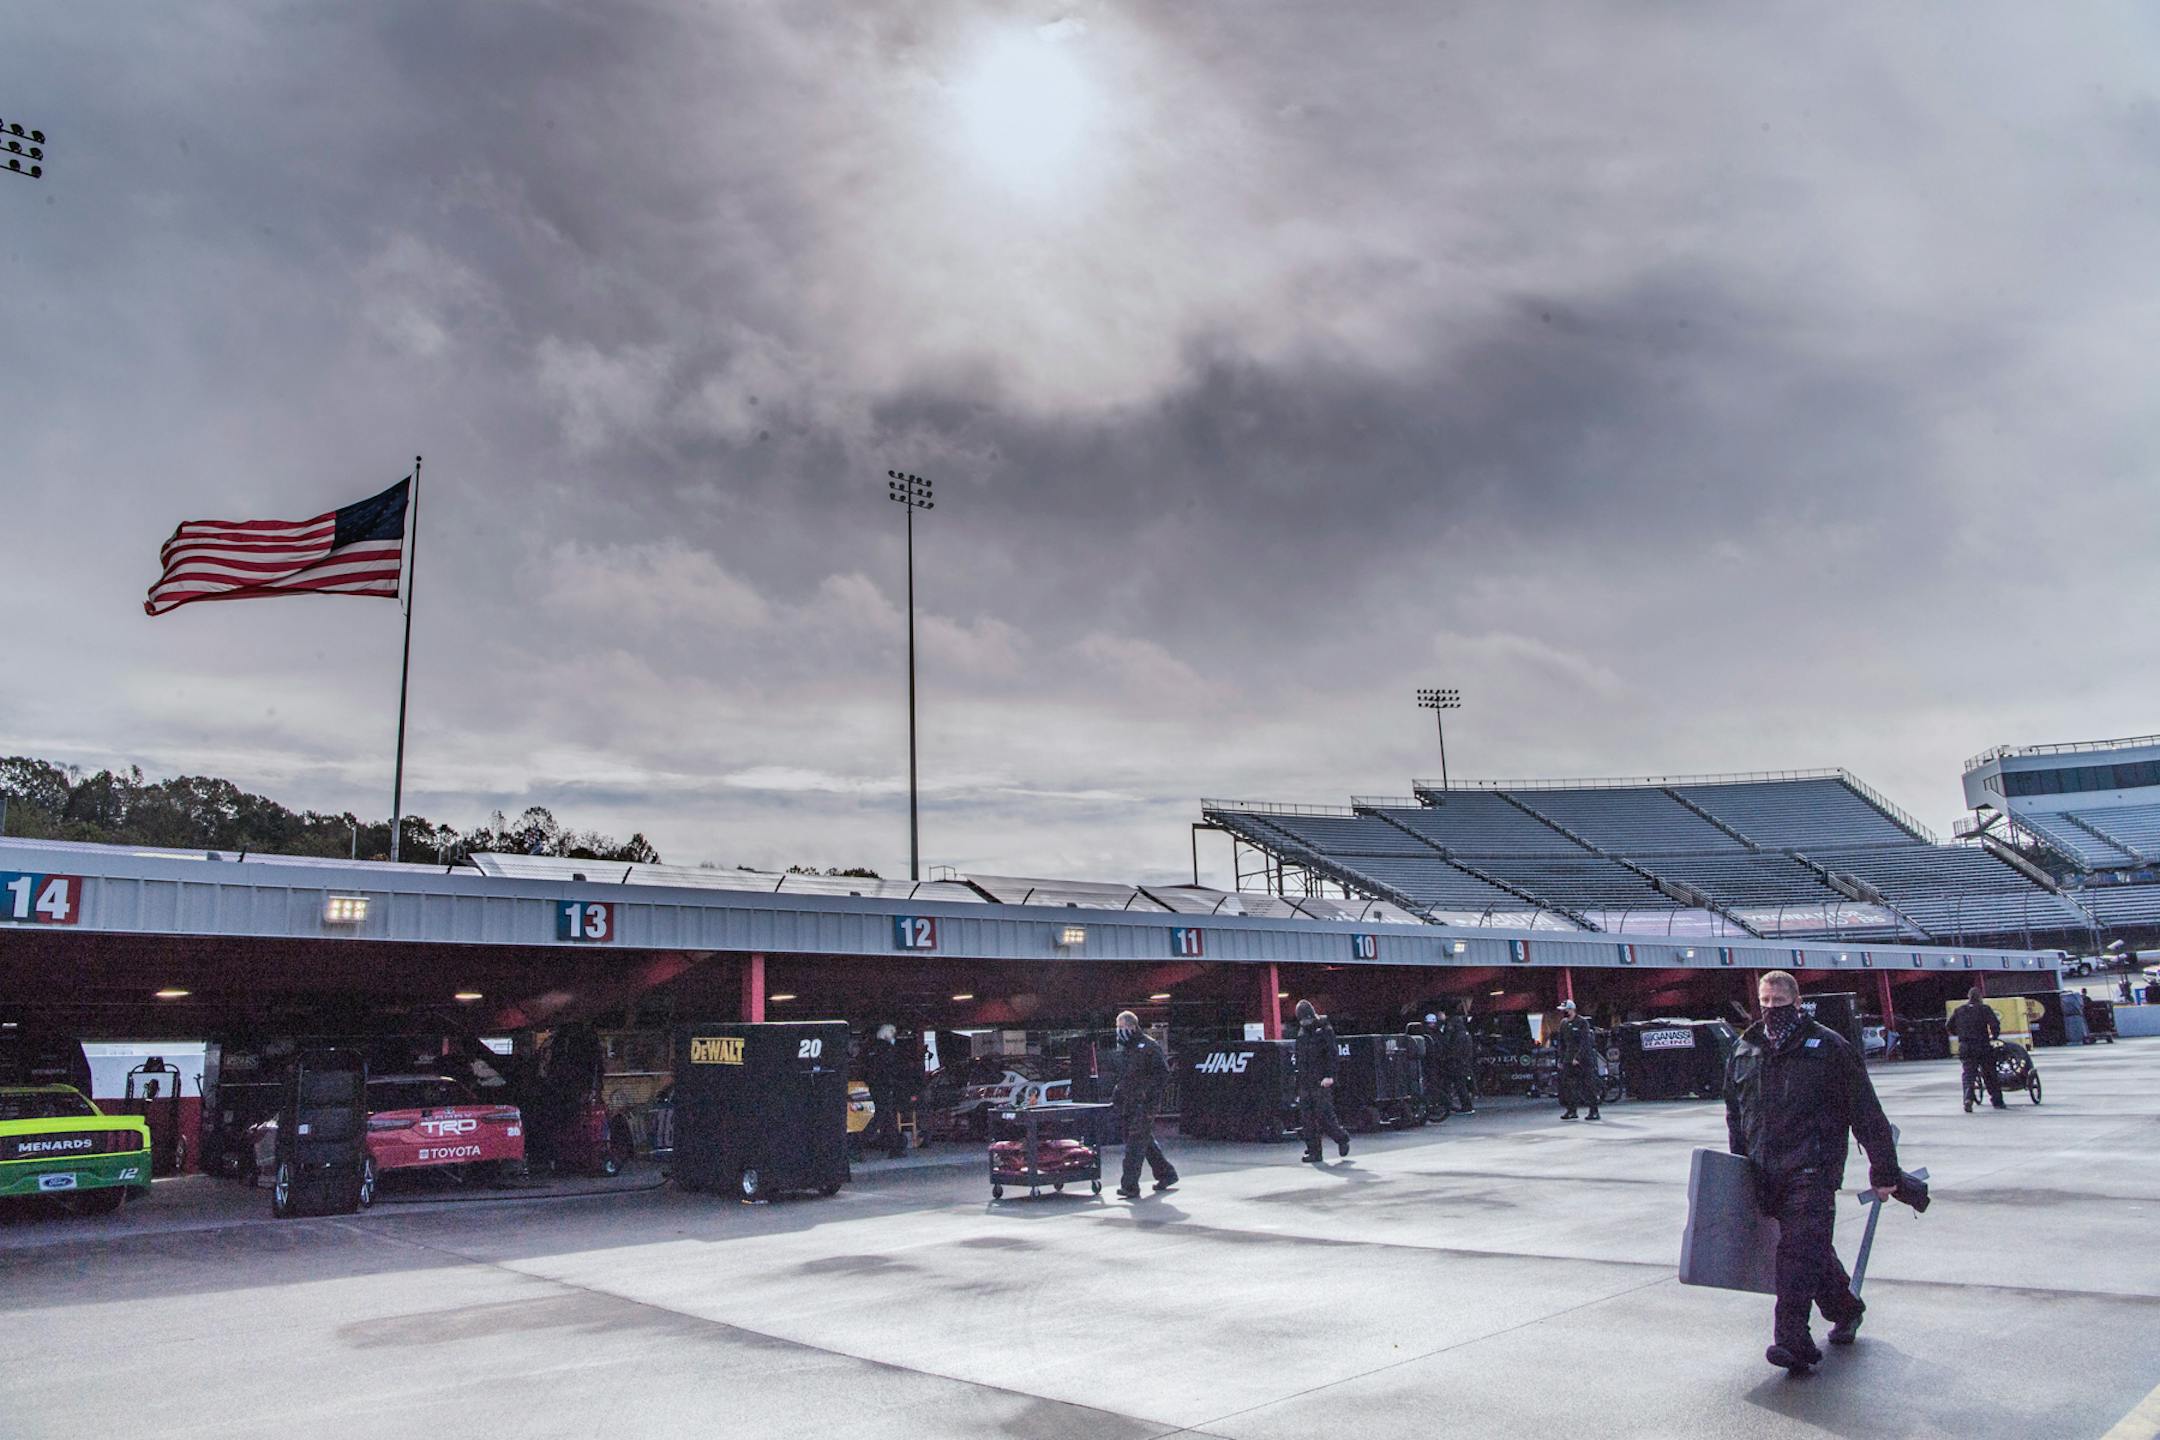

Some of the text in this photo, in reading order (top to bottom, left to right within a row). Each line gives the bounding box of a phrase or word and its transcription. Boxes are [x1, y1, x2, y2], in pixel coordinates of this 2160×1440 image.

[8, 877, 70, 919] 14
[565, 903, 607, 938] 13
[901, 918, 932, 947] 12
[1177, 930, 1199, 954] 11
[1356, 935, 1375, 958] 10
[1517, 941, 1525, 960] 9
[1624, 945, 1632, 962] 8
[1651, 1030, 1691, 1041] GANASSI
[798, 1039, 822, 1058] 20
[1195, 1052, 1254, 1074] HAAS
[420, 1120, 477, 1136] TRD
[18, 1139, 93, 1153] MENARDS
[431, 1145, 481, 1159] TOYOTA
[118, 1167, 139, 1180] 12
